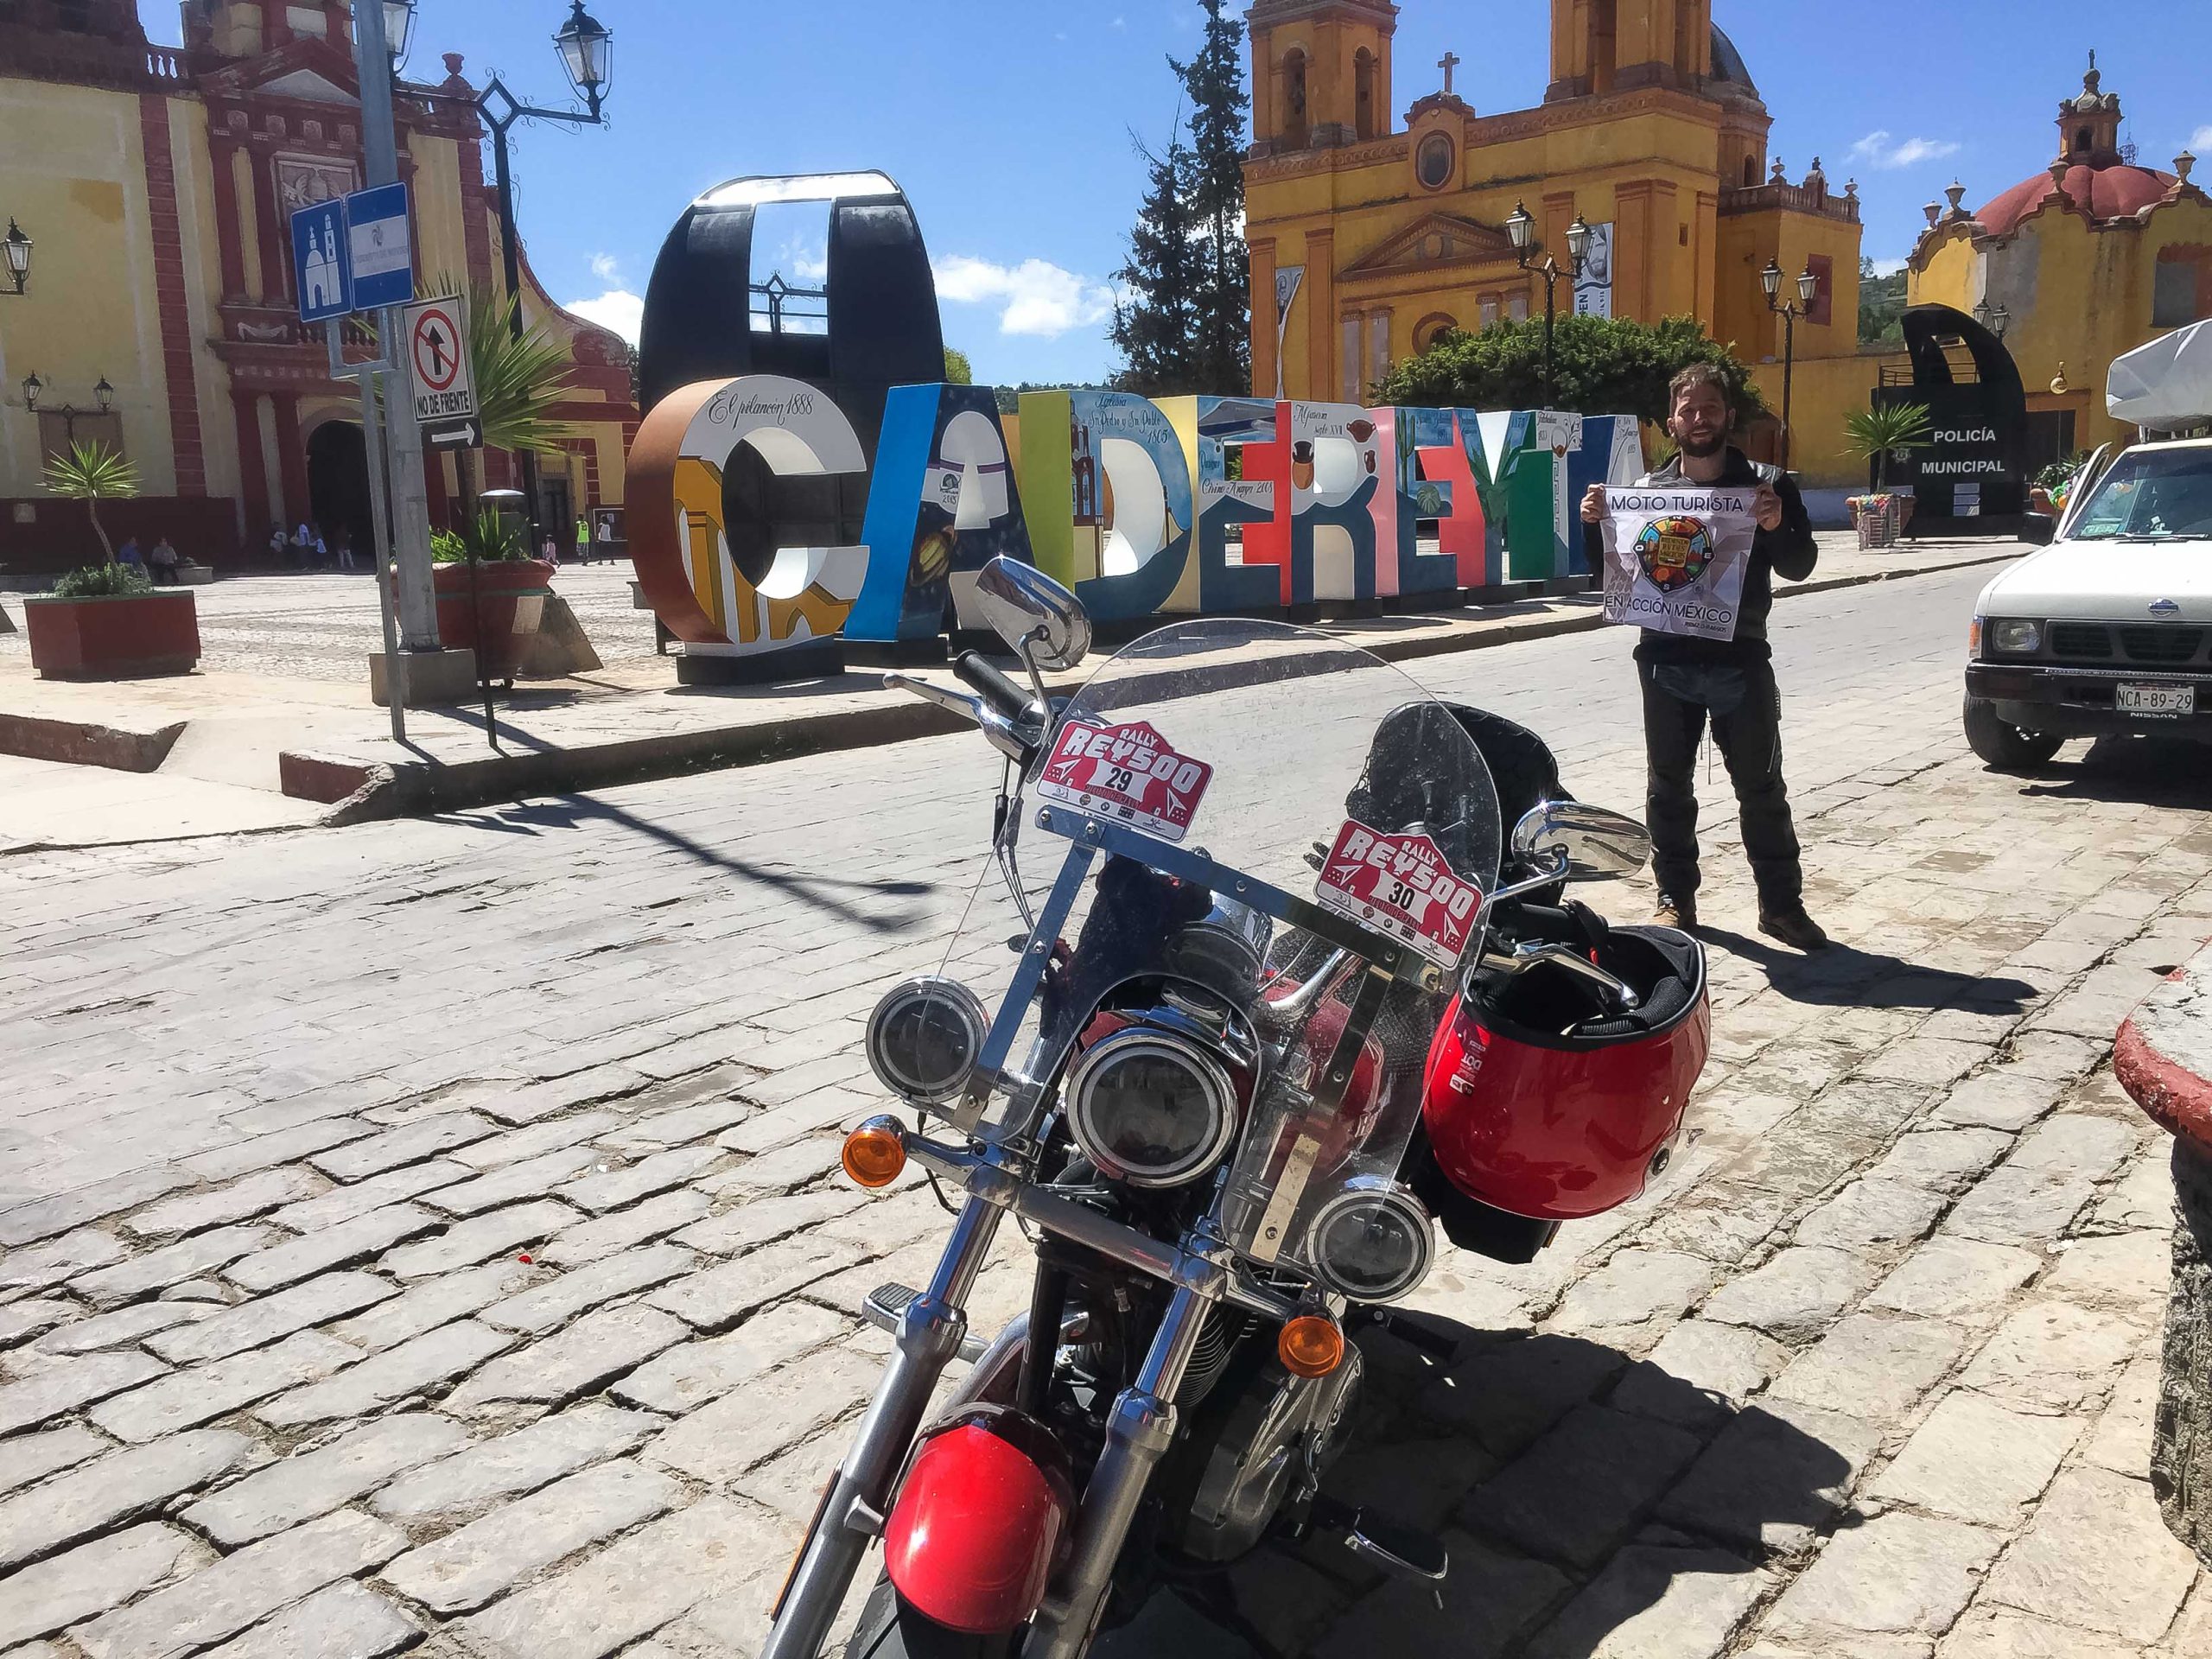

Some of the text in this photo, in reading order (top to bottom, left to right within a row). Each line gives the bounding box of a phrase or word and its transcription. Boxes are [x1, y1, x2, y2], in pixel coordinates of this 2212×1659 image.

[416, 391, 469, 416] NO DE FRENTE
[709, 390, 738, 424] El
[785, 393, 813, 416] 1888
[1934, 427, 1996, 442] POLICÍA
[1922, 461, 2005, 474] MUNICIPAL
[1611, 496, 1744, 512] MOTO TURISTA
[1605, 595, 1732, 624] EN ACCIÓN MÉXICO
[2117, 690, 2192, 709] NCA-89-29
[1119, 728, 1160, 748] RALLY
[1061, 727, 1203, 794] REY500
[1105, 767, 1134, 791] 29
[1402, 840, 1439, 867] RALLY
[1340, 829, 1475, 920] REY500
[1388, 881, 1415, 910] 30
[1460, 1052, 1483, 1071] DOT
